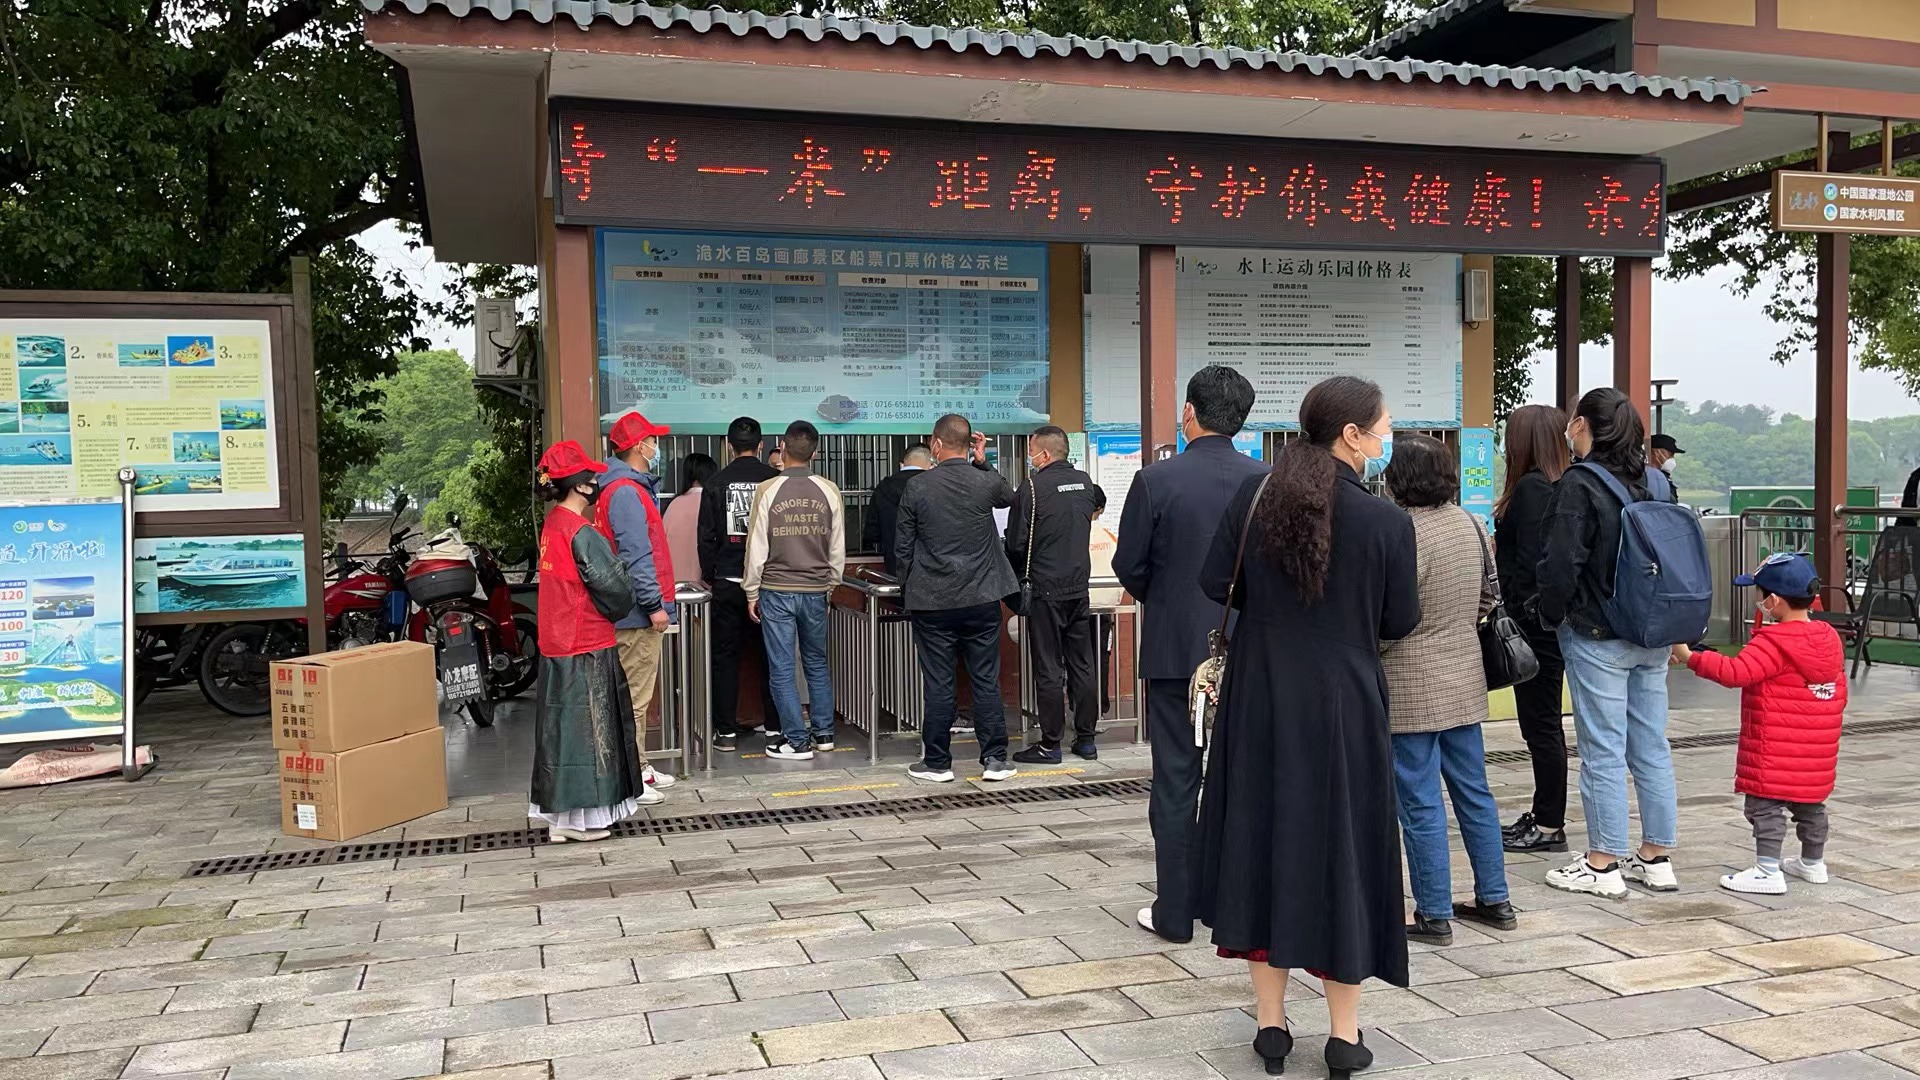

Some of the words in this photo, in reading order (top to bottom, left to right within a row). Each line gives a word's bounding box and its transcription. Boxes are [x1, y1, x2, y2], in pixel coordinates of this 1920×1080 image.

[1840, 186, 1914, 202] 中国国家湿地公园
[1840, 206, 1905, 222] 国家水利风景区
[696, 244, 1009, 271] 洈水百岛画廊景区船票门票价格公示栏
[1237, 257, 1412, 279] 水上运动乐园价格表
[771, 498, 809, 516] IGNORE
[811, 499, 828, 514] THE
[784, 513, 819, 523] WASTE
[772, 526, 809, 537] BEHIND
[0, 590, 24, 601] 120
[0, 621, 23, 632] 100
[4, 651, 19, 662] 30
